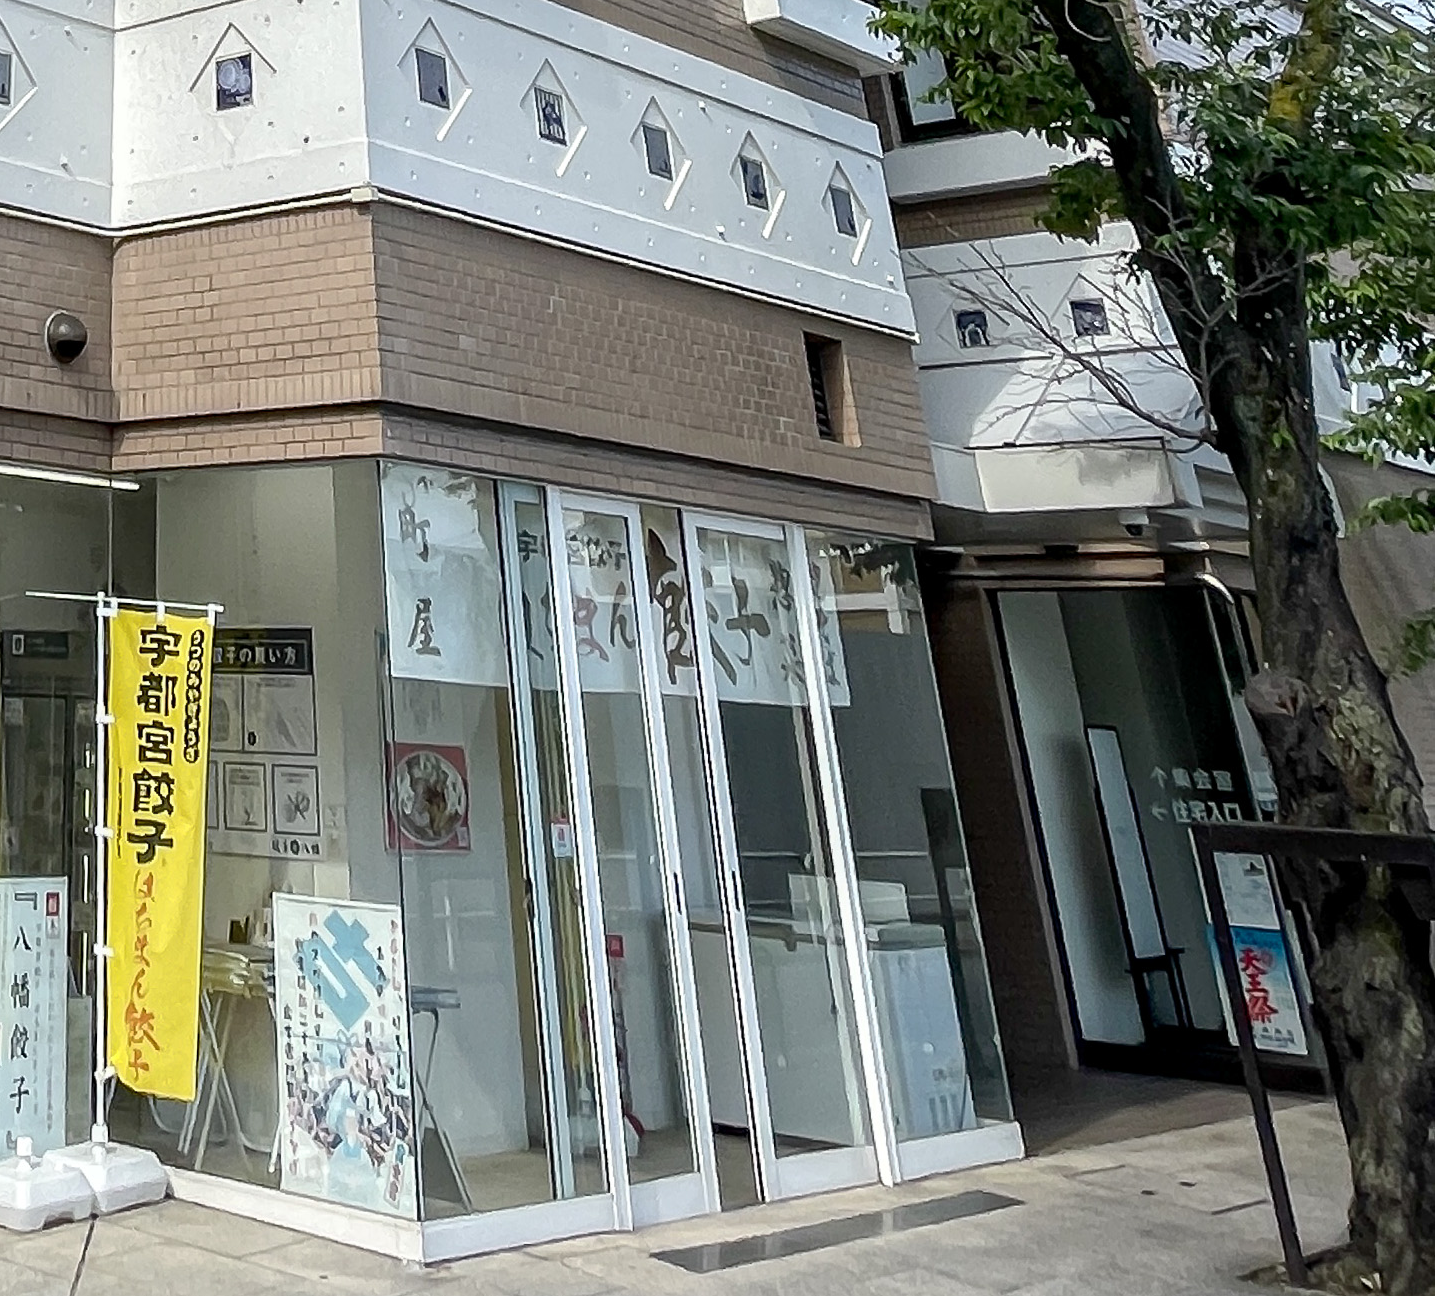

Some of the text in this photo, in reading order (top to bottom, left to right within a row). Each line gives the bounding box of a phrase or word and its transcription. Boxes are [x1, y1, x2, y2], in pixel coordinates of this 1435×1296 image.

[126, 624, 182, 864] 宇都宮餃子
[125, 868, 161, 1082] はちまん餃子
